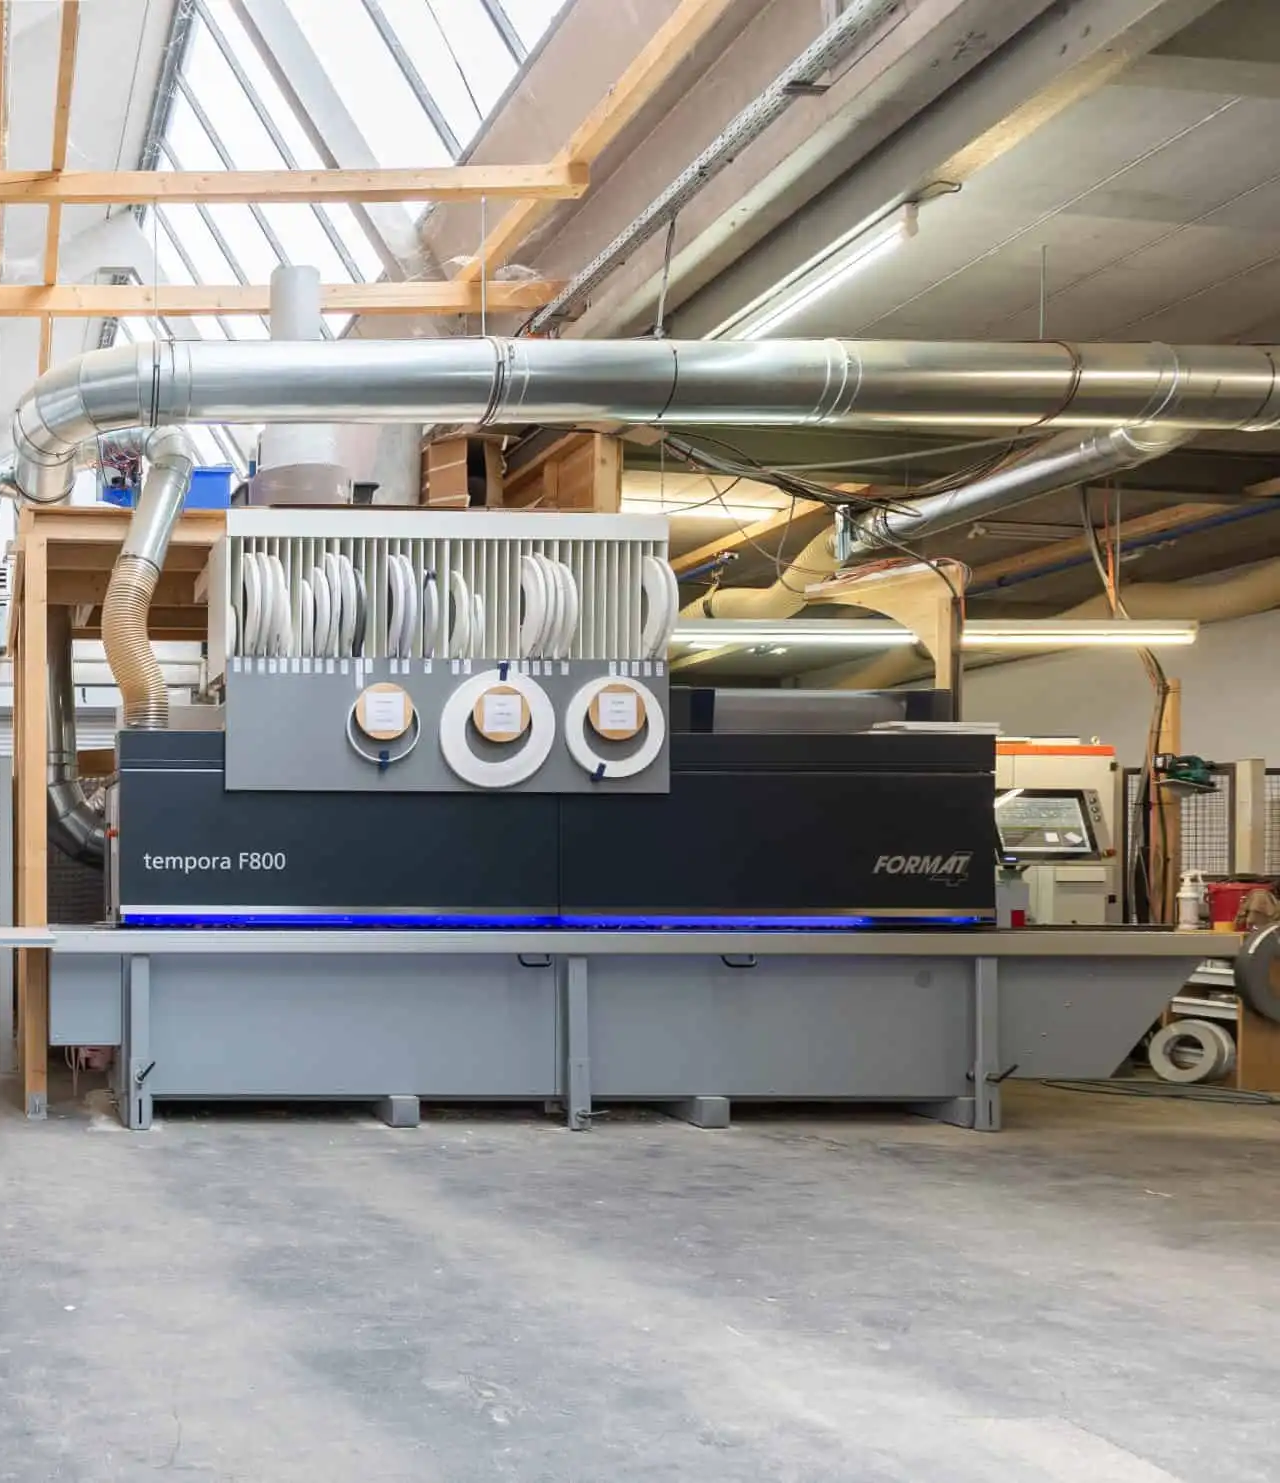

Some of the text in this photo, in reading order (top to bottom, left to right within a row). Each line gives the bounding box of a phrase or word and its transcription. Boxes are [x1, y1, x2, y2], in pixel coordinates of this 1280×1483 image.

[143, 852, 286, 875] tempora F800
[871, 854, 971, 875] FORMAT
